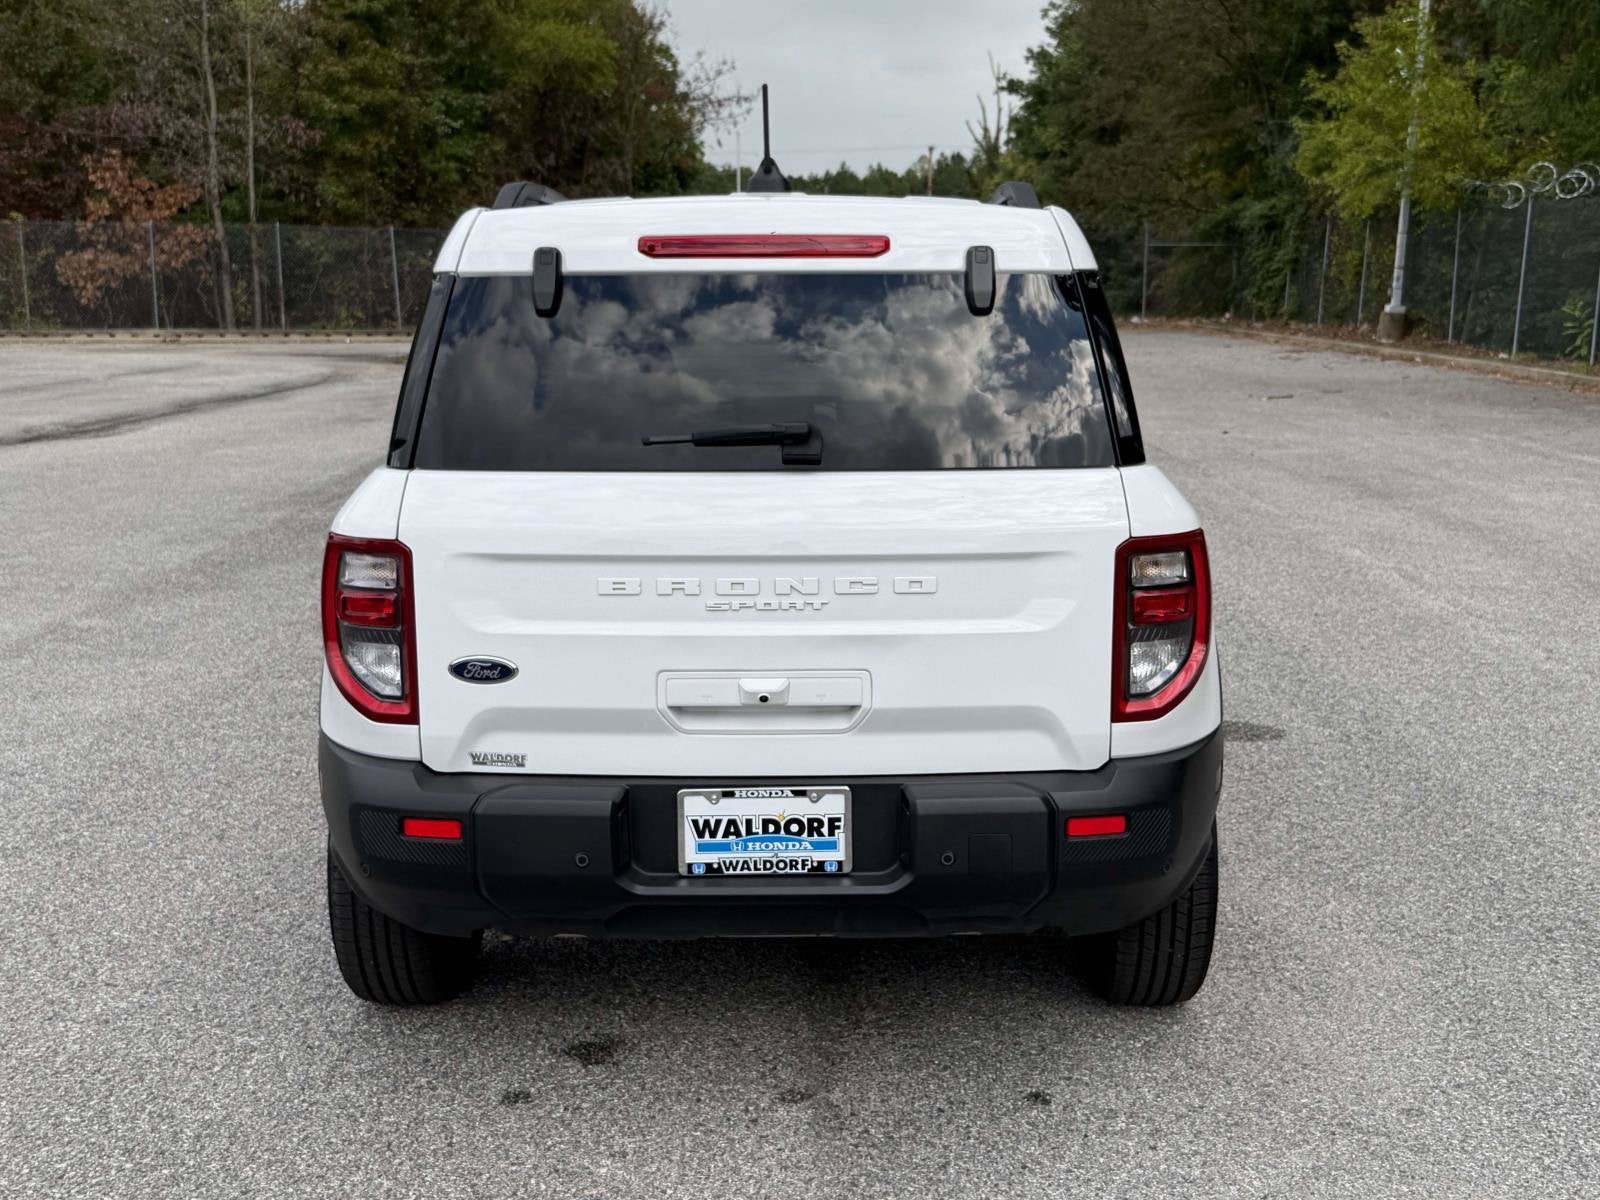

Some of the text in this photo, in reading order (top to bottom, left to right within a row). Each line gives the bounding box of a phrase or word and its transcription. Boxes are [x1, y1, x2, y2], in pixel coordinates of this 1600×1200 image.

[597, 576, 937, 596] BRONCO
[705, 600, 829, 611] SPORT
[463, 662, 501, 678] Ford
[470, 752, 527, 763] WALDORF
[734, 790, 794, 798] HONDA
[690, 817, 842, 839] WALDORF
[746, 842, 814, 850] HONDA
[722, 859, 810, 872] WALDORF
